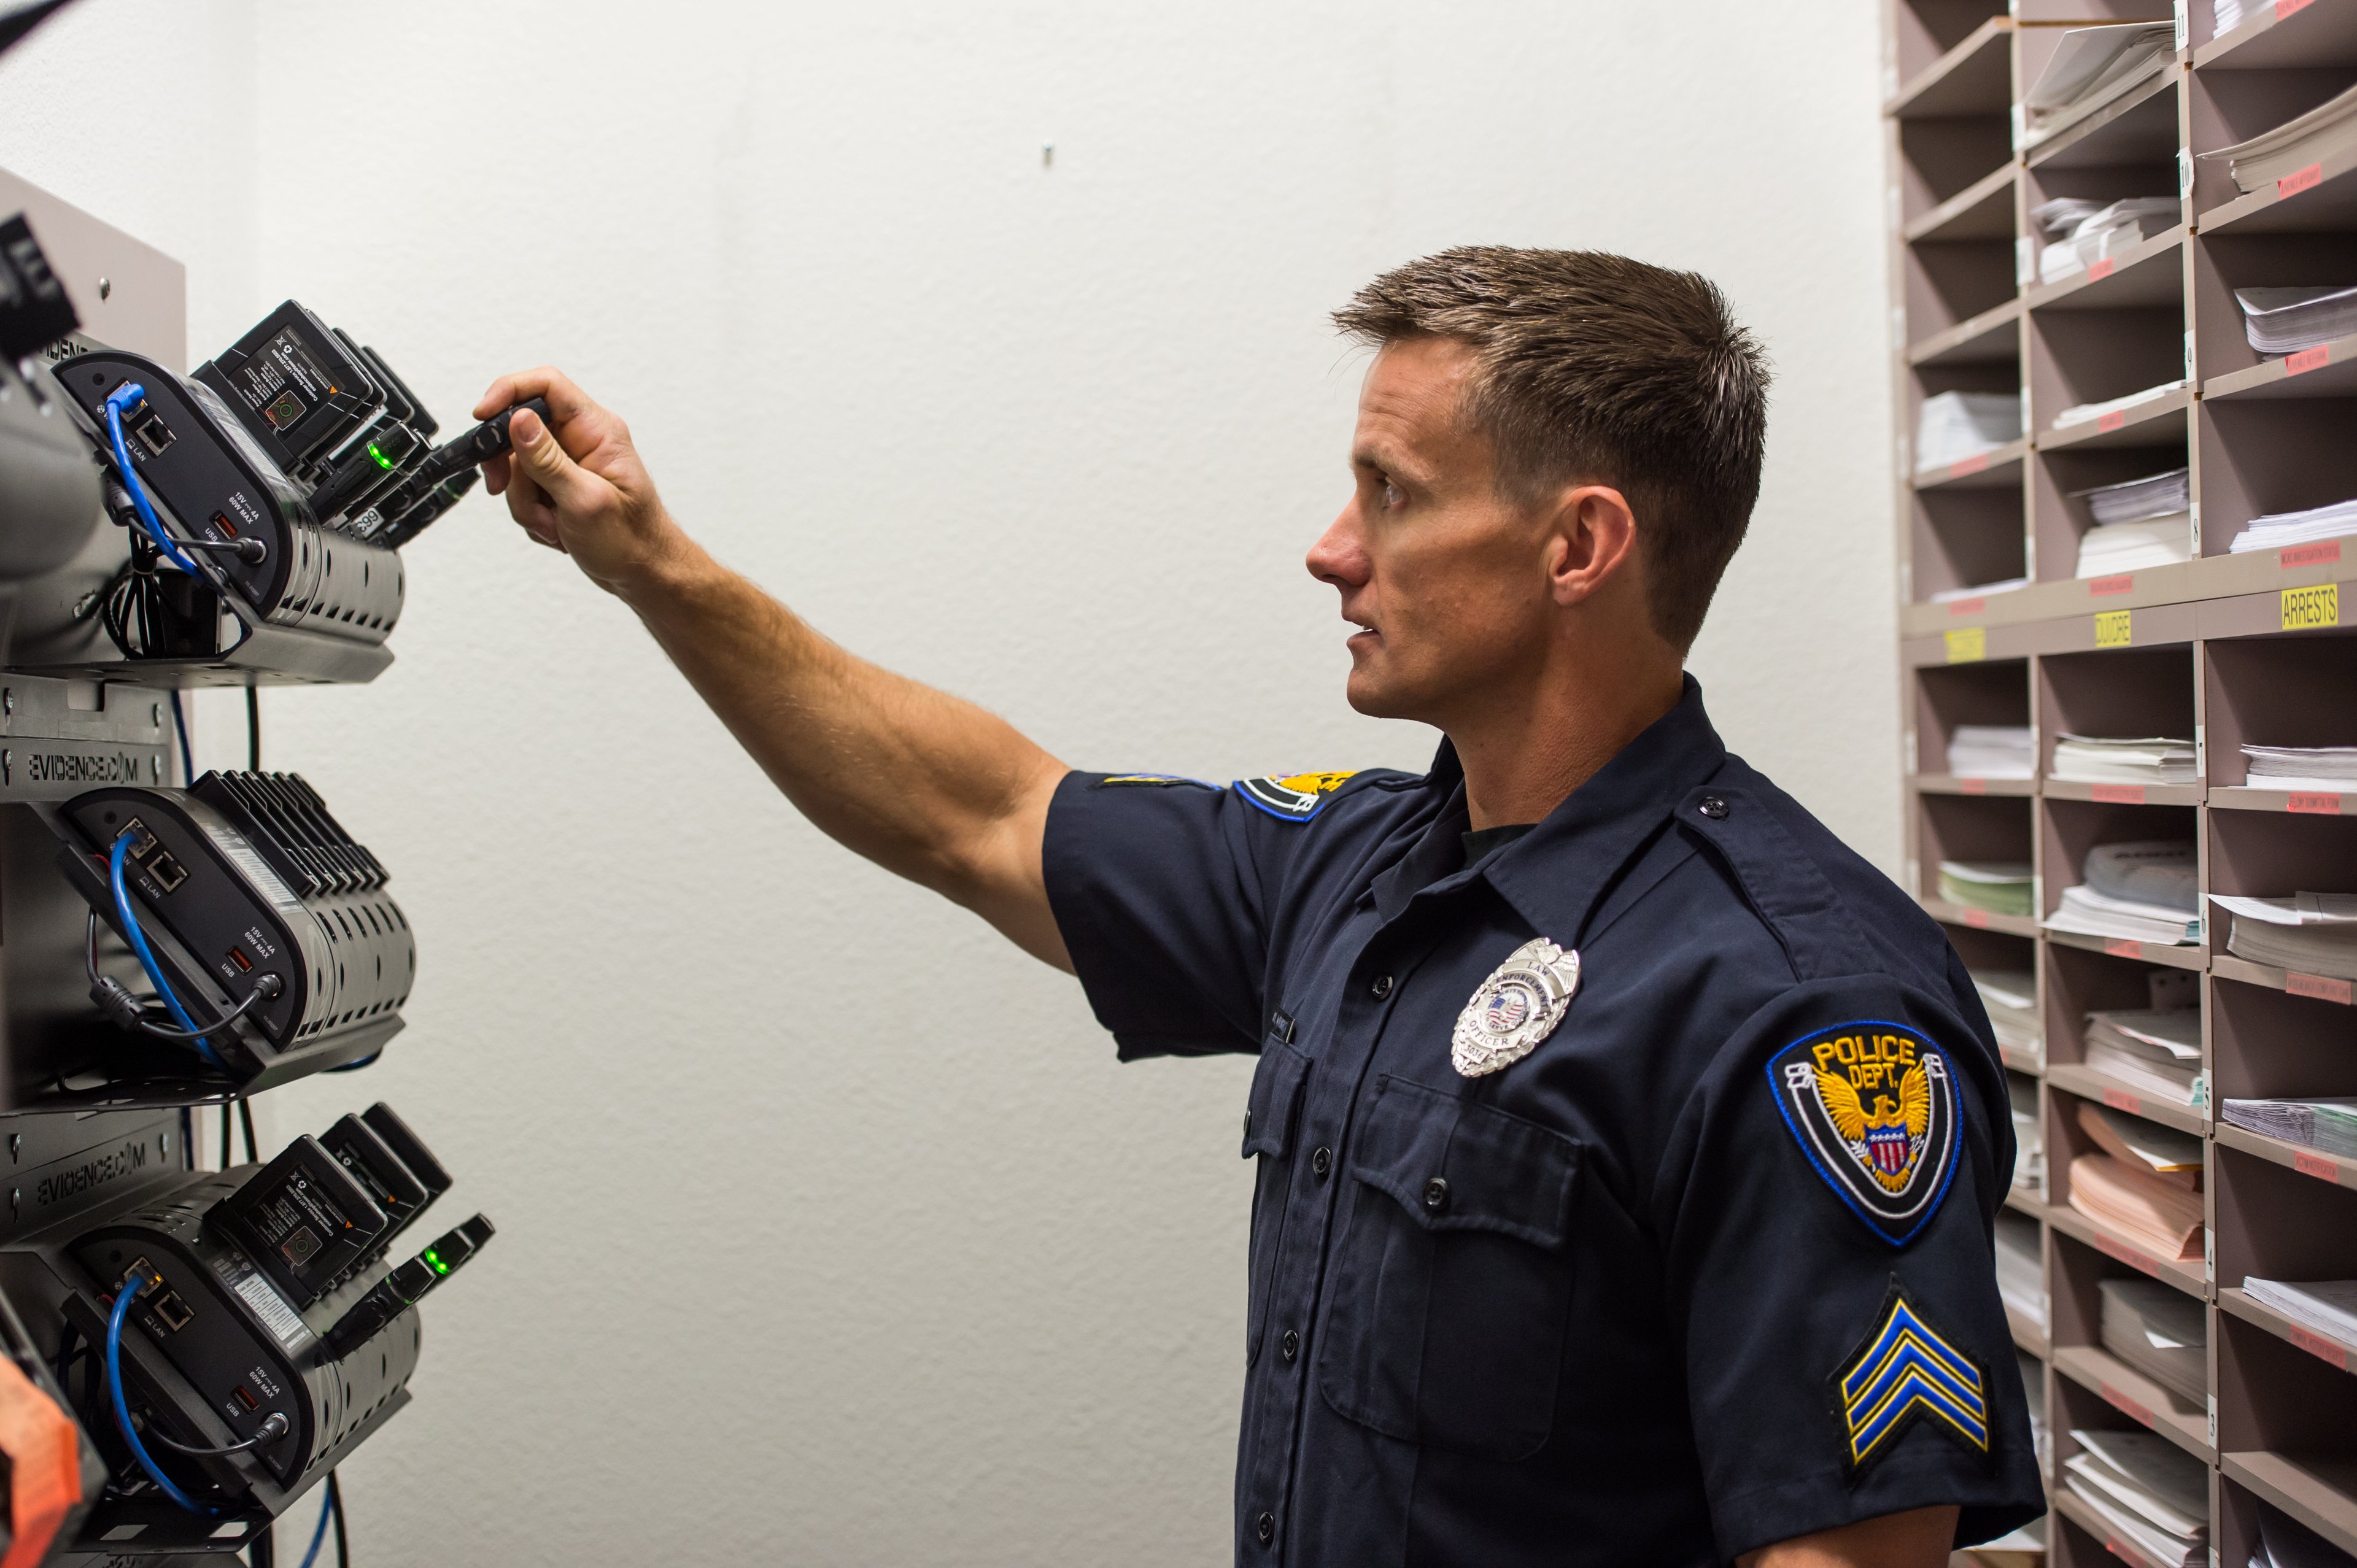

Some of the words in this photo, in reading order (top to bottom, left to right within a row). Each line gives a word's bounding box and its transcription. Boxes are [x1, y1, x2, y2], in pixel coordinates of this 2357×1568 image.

[2177, 13, 2185, 39] 11
[2181, 162, 2189, 188] 10
[2188, 347, 2192, 371] 9
[291, 371, 304, 385] Service
[302, 384, 317, 401] Customer
[133, 447, 146, 462] LAN
[229, 496, 242, 510] 60W
[239, 509, 254, 524] MAX
[235, 492, 247, 503] 15V
[250, 511, 259, 520] 4A
[205, 528, 218, 541] USB
[2194, 519, 2199, 542] 8
[2283, 588, 2336, 625] ARRESTS
[2199, 742, 2202, 766] 7
[29, 752, 137, 784] EVIDENCE.COM
[147, 885, 161, 898] LAN
[2202, 910, 2206, 933] 6
[244, 932, 258, 944] 60W
[256, 944, 269, 959] MAX
[250, 927, 263, 938] 15V
[266, 945, 275, 954] 4A
[222, 963, 235, 978] USB
[1527, 962, 1550, 976] LAW
[1496, 973, 1549, 1008] ENFORCEMENT
[1469, 1020, 1508, 1046] OFFICER
[1464, 1045, 1484, 1060] 3036
[1813, 1035, 1916, 1071] POLICE
[1849, 1062, 1899, 1090] DEPT.
[2205, 1086, 2209, 1110] 5
[37, 1142, 145, 1205] EVIDENCE.COM
[306, 1207, 319, 1220] Service
[318, 1219, 333, 1236] Customer
[2208, 1248, 2212, 1271] 4
[153, 1323, 166, 1338] LAN
[249, 1371, 263, 1385] 60W
[260, 1383, 274, 1399] MAX
[255, 1366, 267, 1378] 15V
[271, 1385, 280, 1394] 4A
[226, 1402, 239, 1417] USB
[2210, 1413, 2215, 1437] 3
